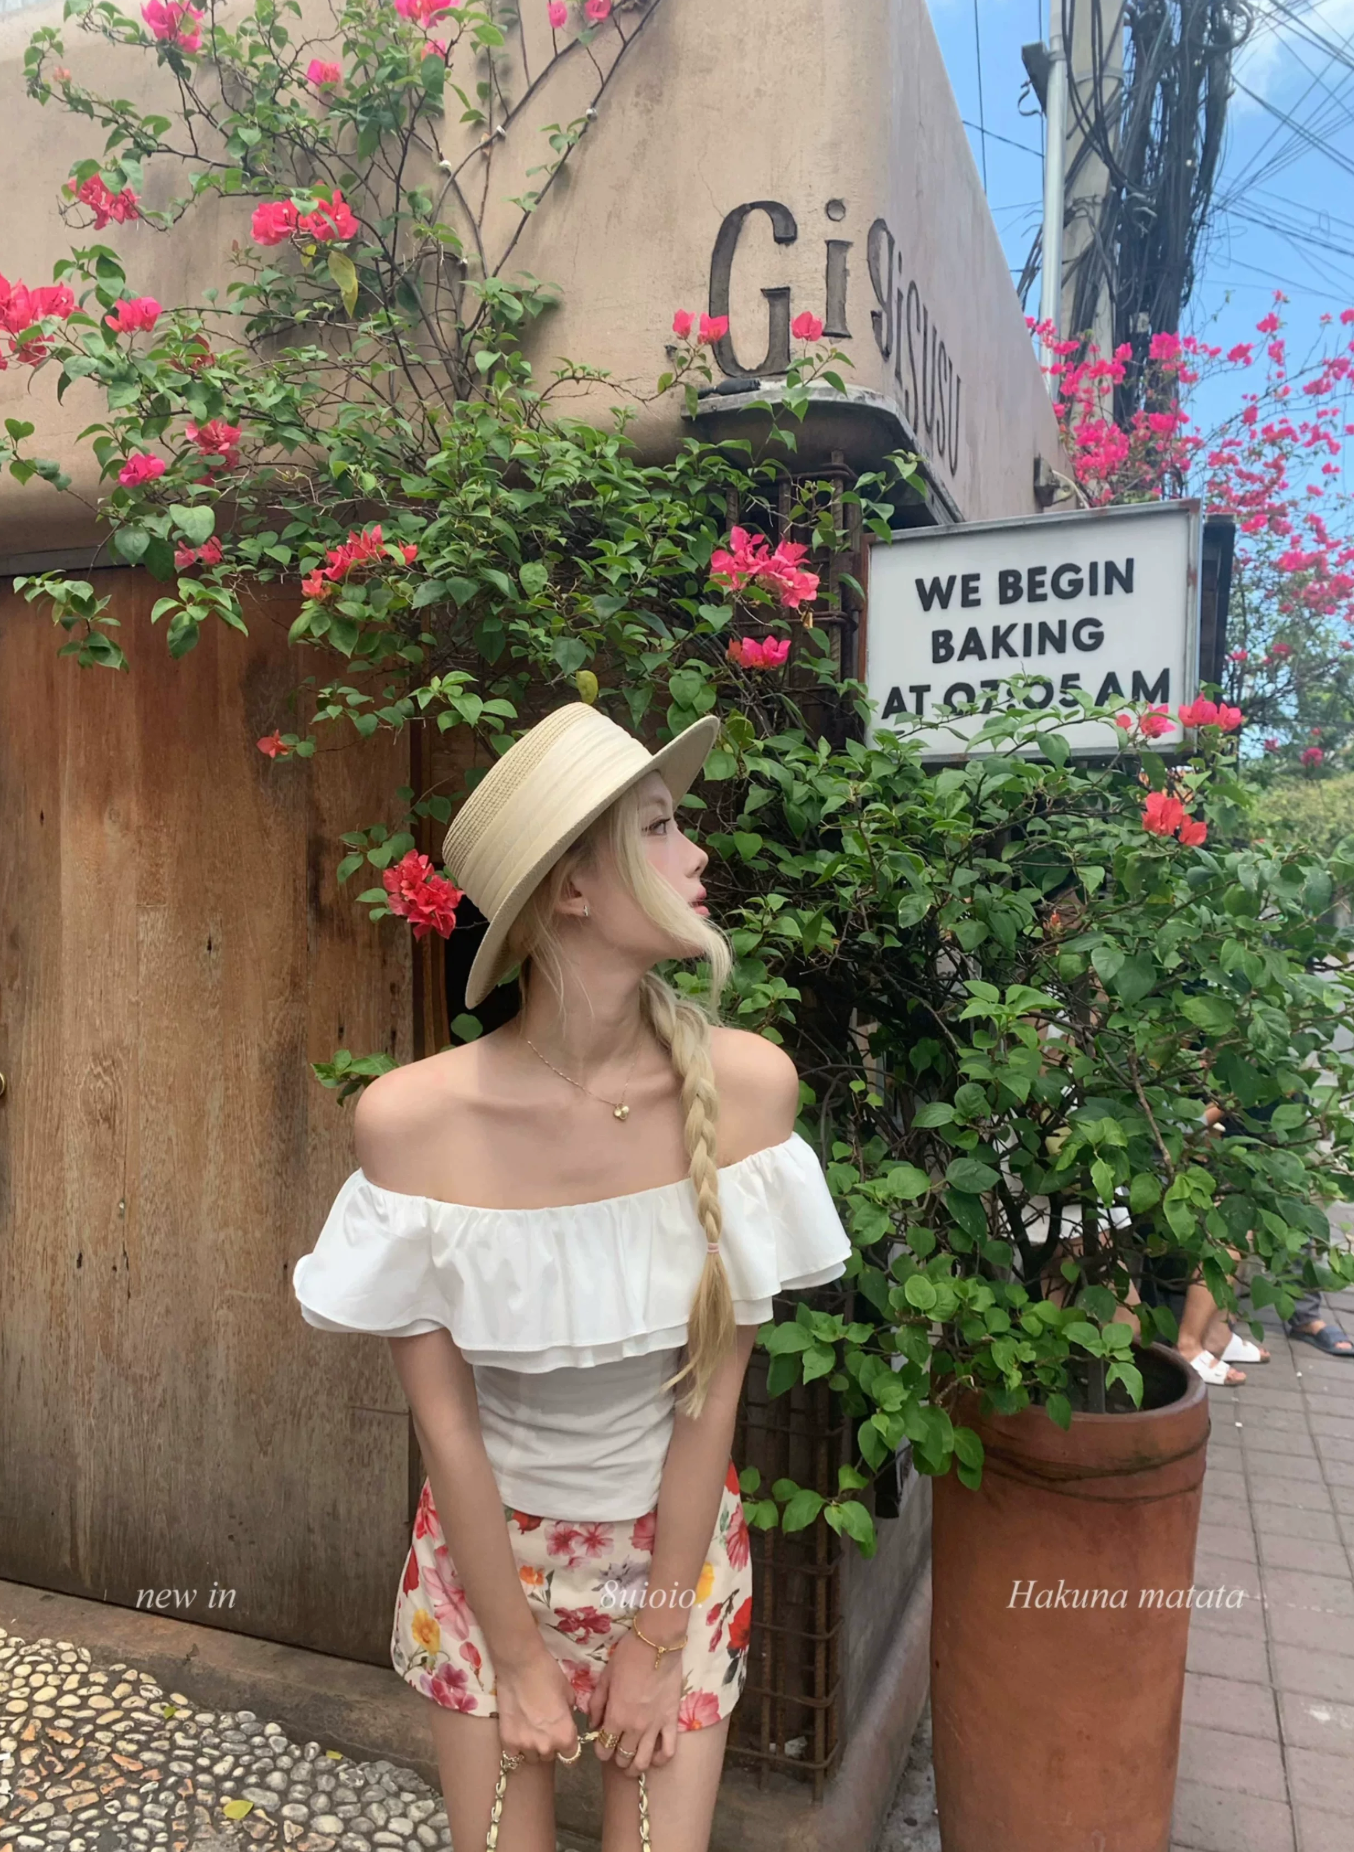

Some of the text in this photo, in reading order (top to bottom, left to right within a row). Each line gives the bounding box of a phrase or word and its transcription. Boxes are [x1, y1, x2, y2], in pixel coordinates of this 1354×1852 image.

[915, 558, 1134, 612] WE BEGIN
[932, 617, 1104, 663] BAKING
[881, 668, 1170, 720] AT 07:05 AM
